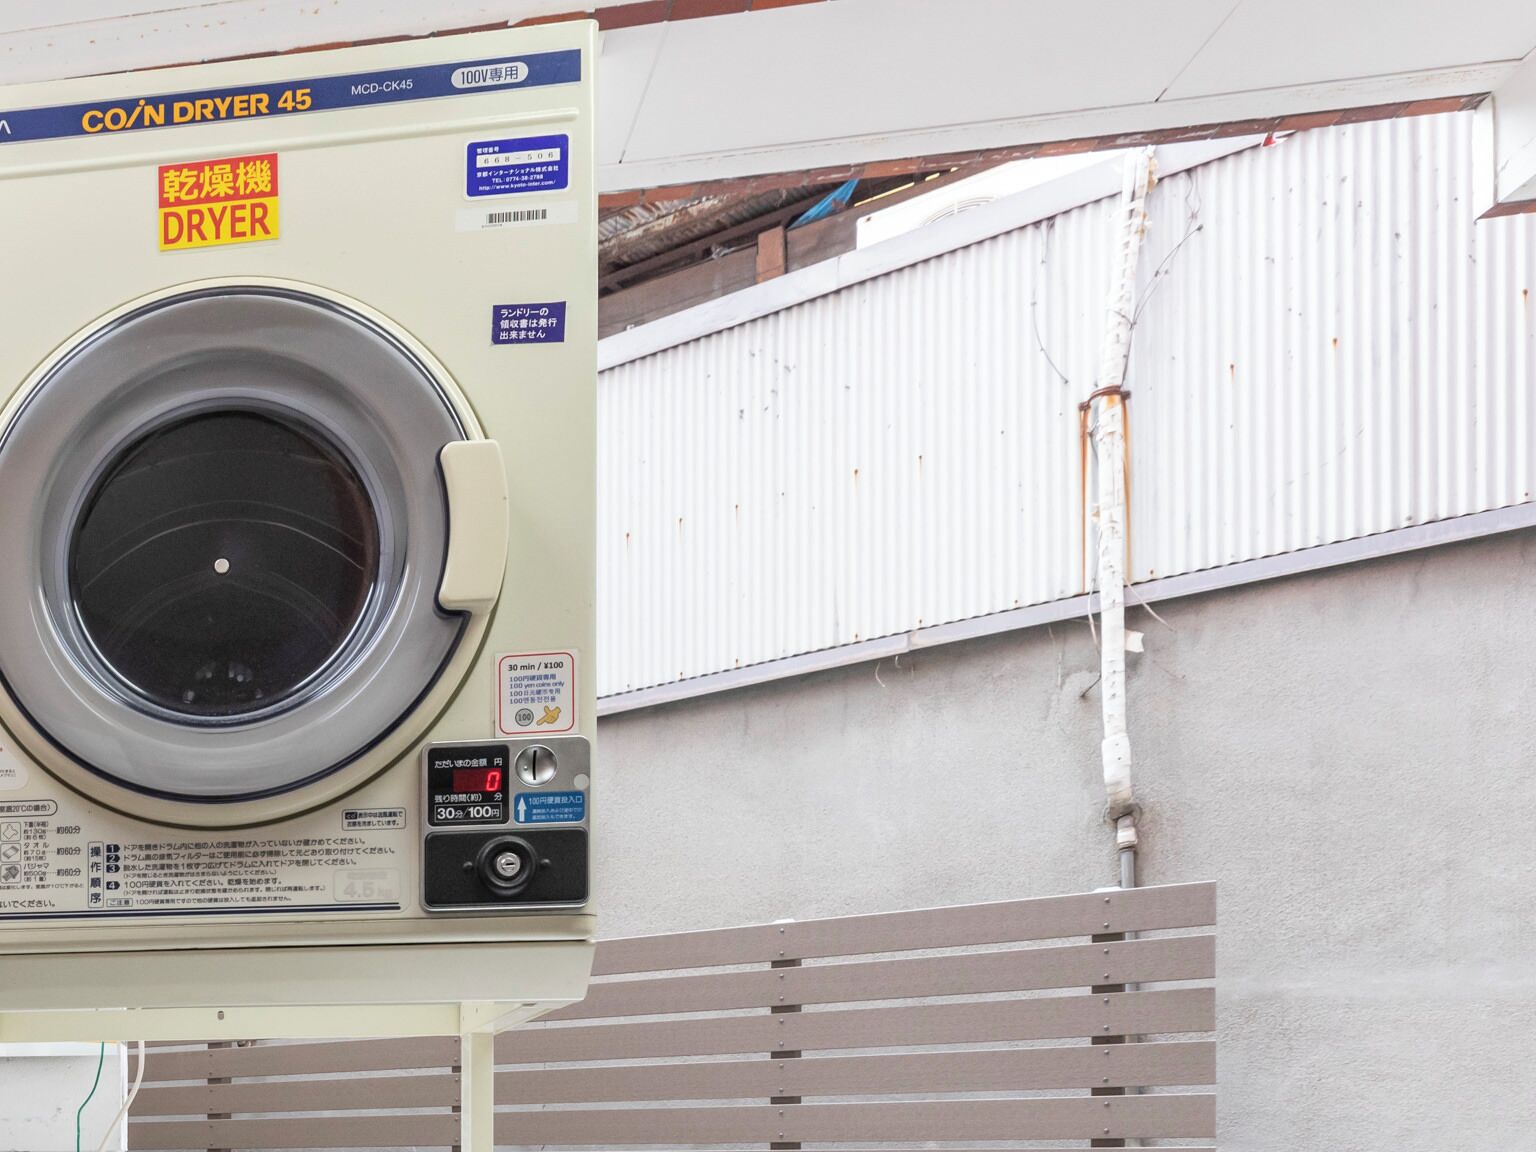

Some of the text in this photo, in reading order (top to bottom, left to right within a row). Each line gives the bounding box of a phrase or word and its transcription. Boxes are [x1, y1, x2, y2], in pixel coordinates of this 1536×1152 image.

[81, 98, 164, 133] COIN
[173, 92, 269, 123] DRYER
[277, 88, 312, 111] 45
[351, 79, 413, 96] MCD-CK45
[460, 65, 519, 86] 100V専用
[163, 159, 272, 203] 乾燥機
[163, 202, 271, 245] DRYER
[500, 307, 549, 318] ランドリーの
[499, 317, 557, 329] 領収書は発行
[499, 329, 546, 340] 出来ません
[537, 661, 542, 671] /
[544, 661, 564, 669] ¥100
[518, 713, 531, 721] 100
[434, 757, 503, 769] ただいまの金額 円
[486, 771, 500, 791] 0
[494, 792, 503, 801] 分
[529, 795, 583, 805] 100円硬貨投入口
[437, 805, 500, 819] 30分/100円
[56, 826, 81, 835] 約60分
[56, 847, 81, 856] 約60分
[56, 868, 81, 877] 約60分
[90, 846, 101, 904] 操作順序
